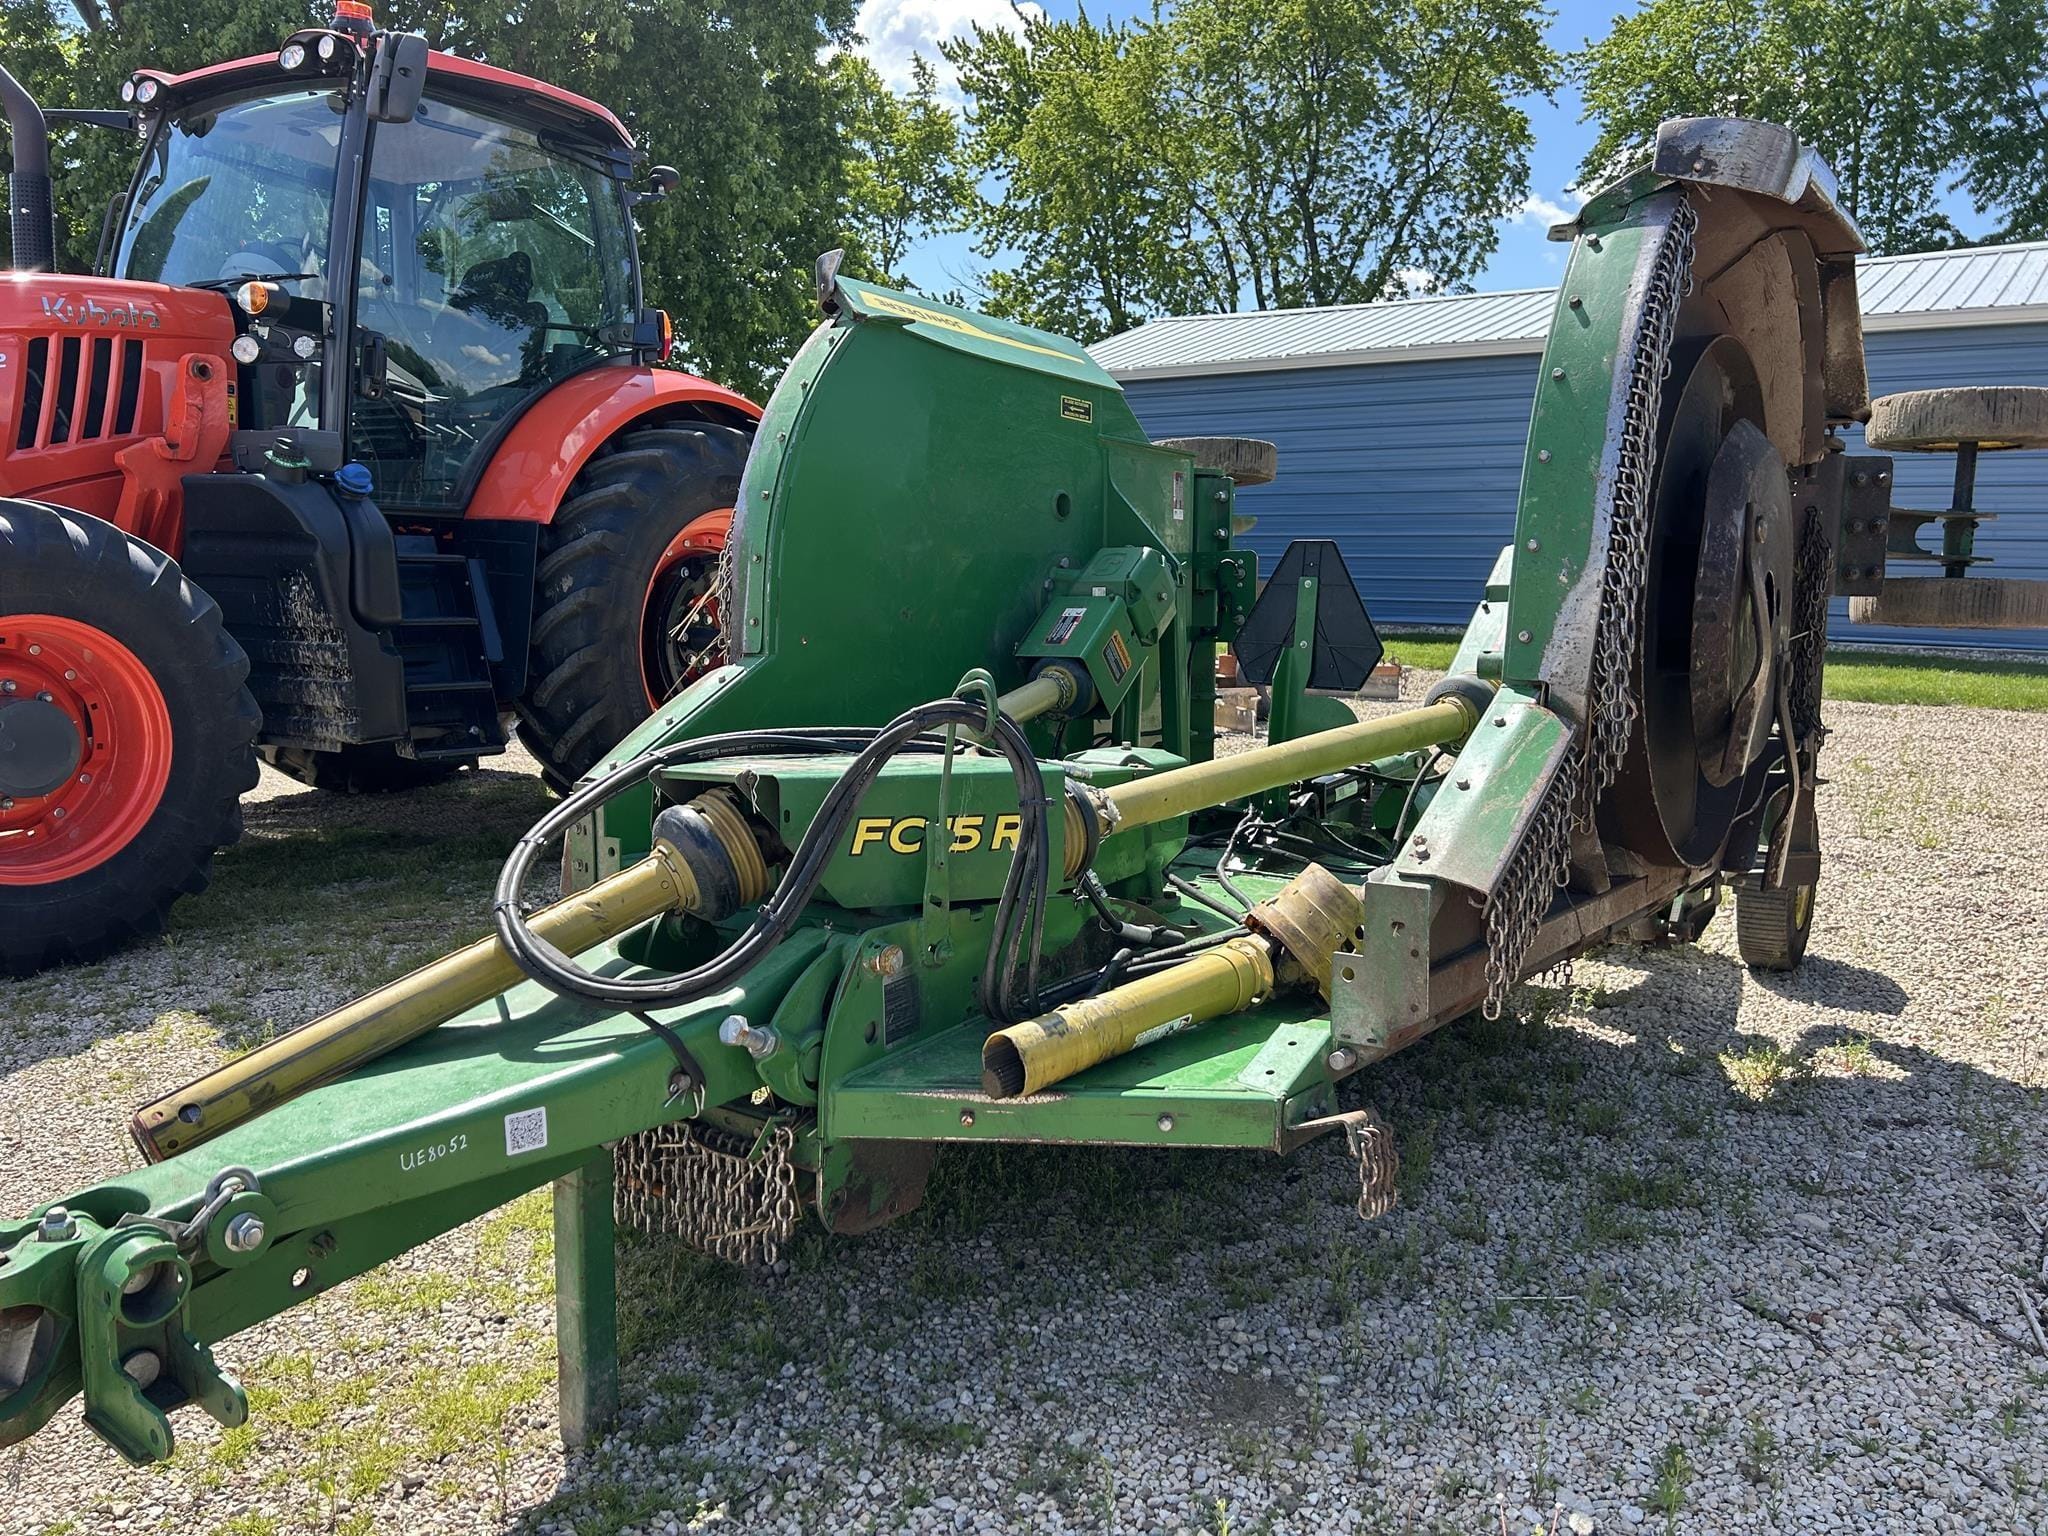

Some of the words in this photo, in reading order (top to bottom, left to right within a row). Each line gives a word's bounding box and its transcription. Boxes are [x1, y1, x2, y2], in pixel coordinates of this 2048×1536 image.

[41, 296, 160, 329] Kubota
[850, 816, 984, 855] FC5
[400, 1134, 468, 1171] UE8052
